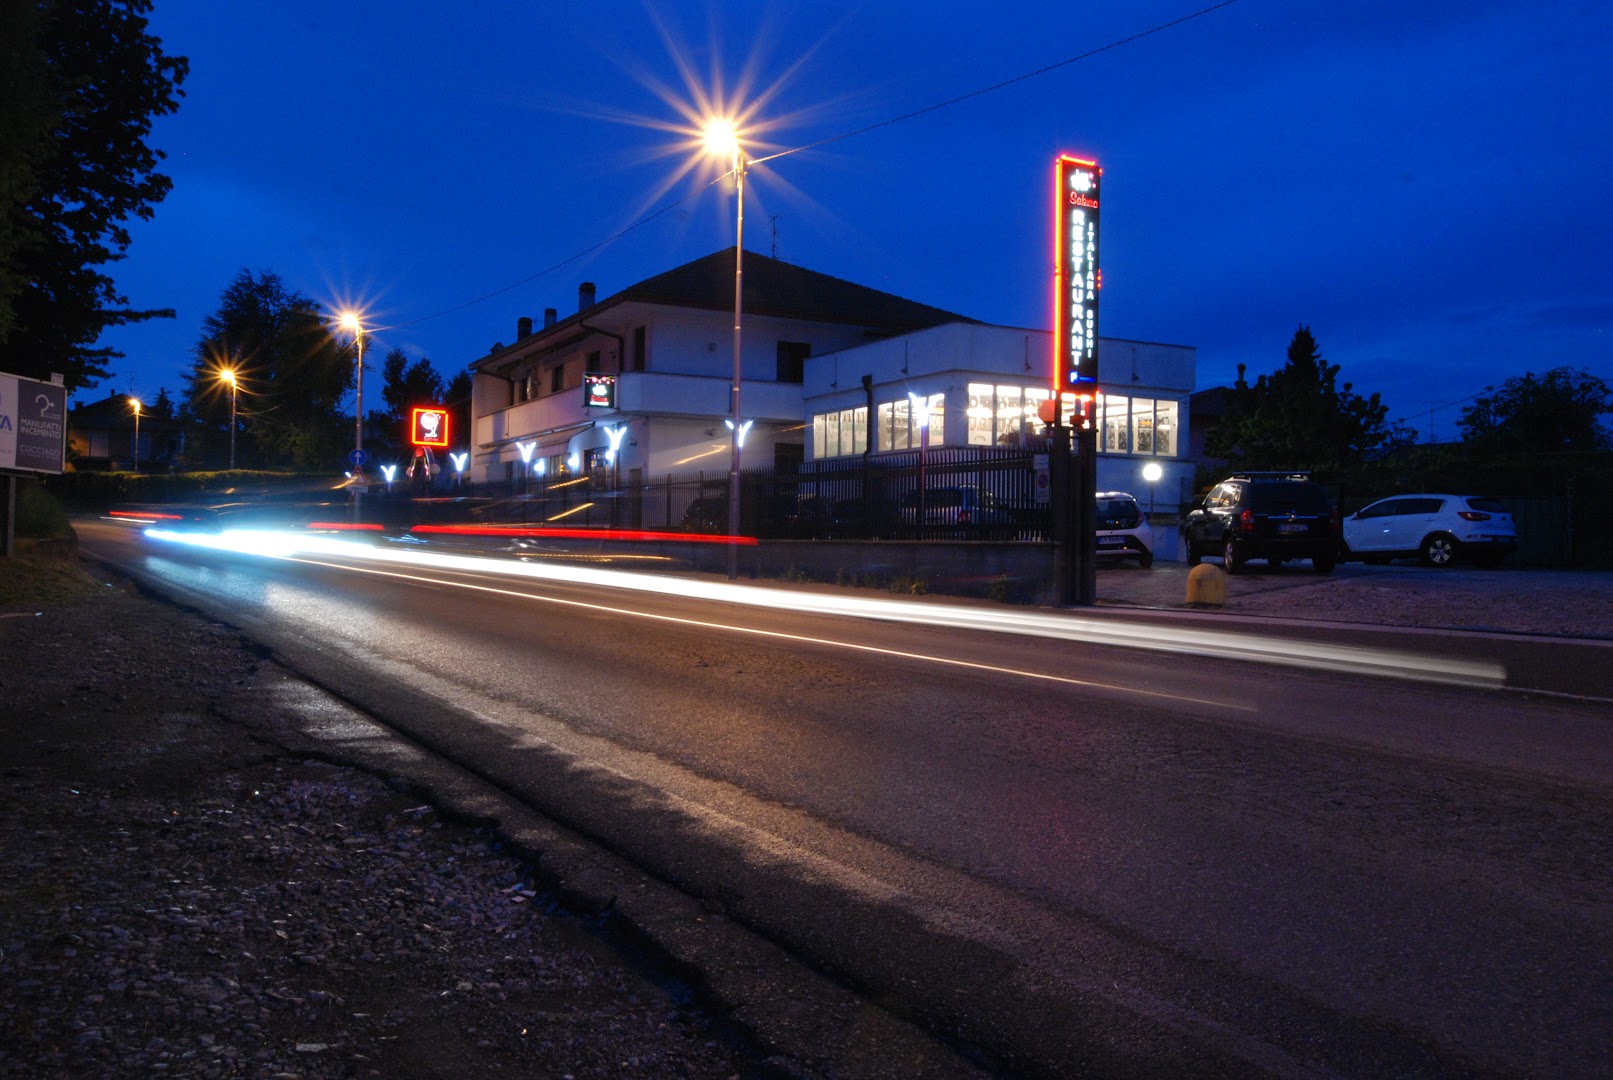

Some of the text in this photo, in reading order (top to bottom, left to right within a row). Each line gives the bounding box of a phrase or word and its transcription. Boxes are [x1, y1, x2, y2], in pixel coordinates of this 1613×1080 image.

[1071, 210, 1084, 366] RESTAURANT
[1086, 222, 1095, 358] ITALIANA SUSHI
[20, 418, 62, 431] MANUFATTI
[20, 445, 61, 456] CUCCIAGO
